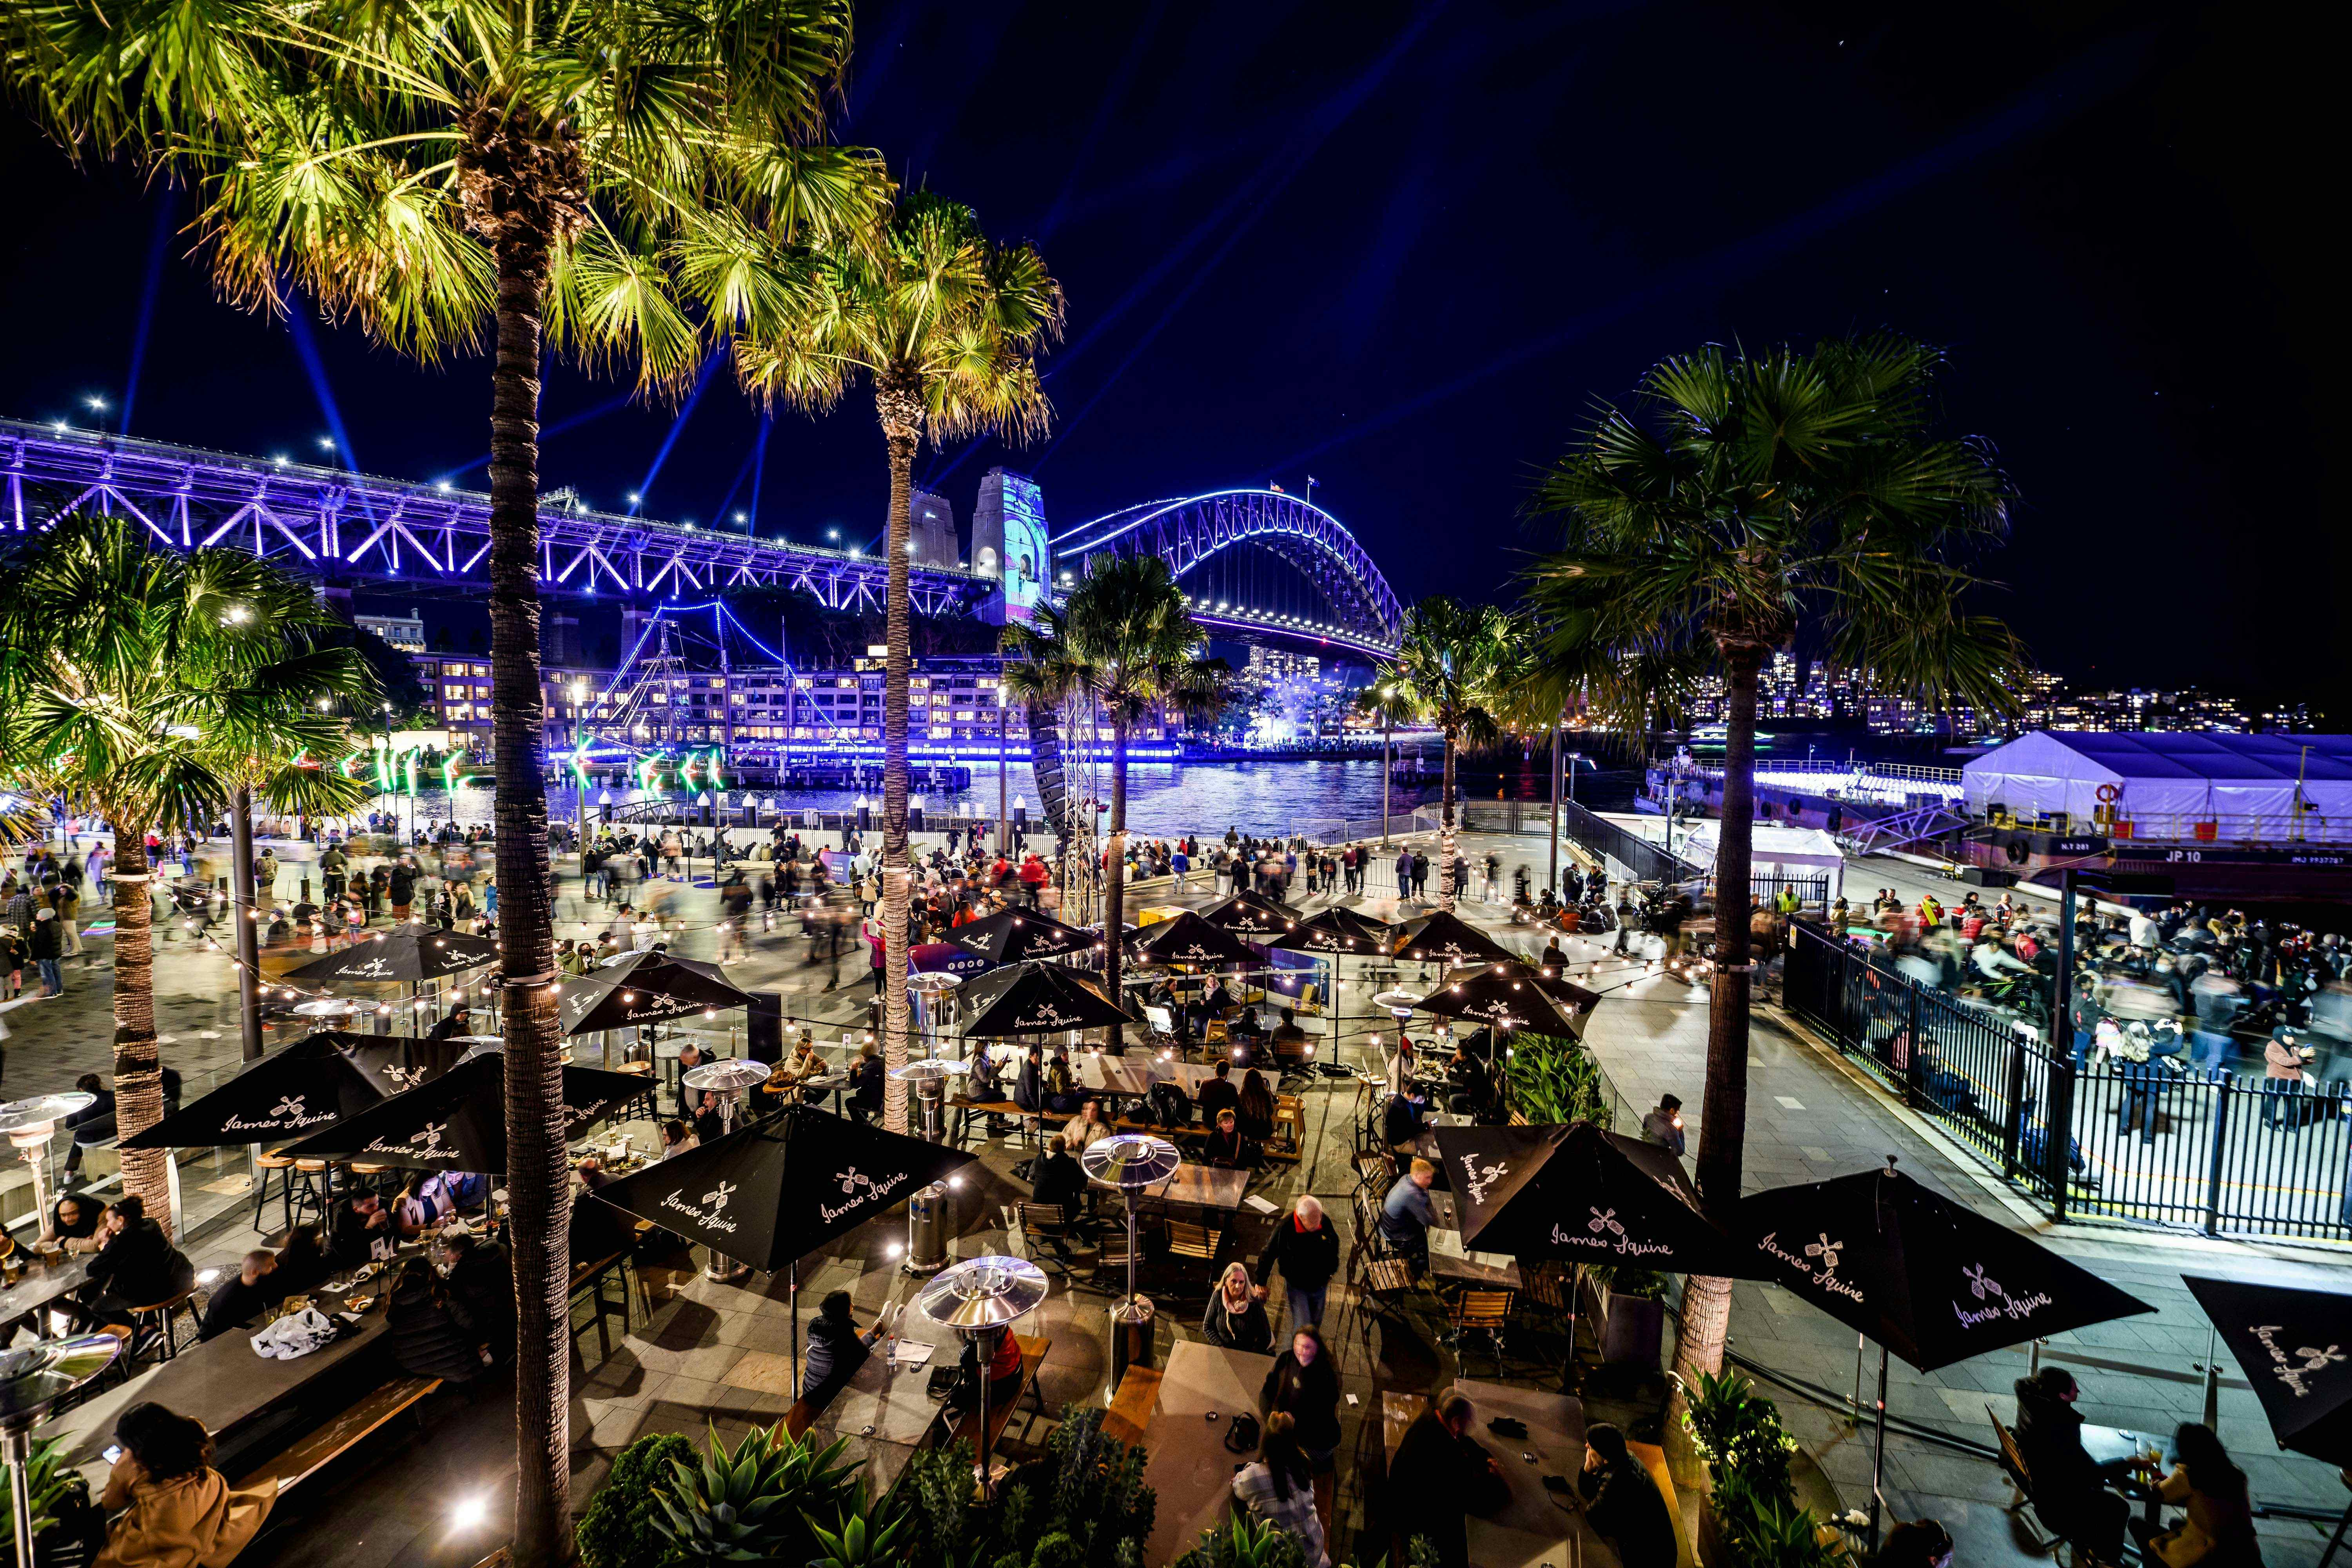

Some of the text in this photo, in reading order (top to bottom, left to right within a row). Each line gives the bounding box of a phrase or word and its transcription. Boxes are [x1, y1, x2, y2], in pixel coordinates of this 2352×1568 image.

[2166, 851, 2201, 862] JP 10
[1047, 942, 1069, 951] Squire
[1172, 951, 1196, 960] James
[1303, 942, 1355, 953] James Squire
[1428, 949, 1453, 957] James
[467, 953, 490, 963] Squire
[1271, 960, 1295, 969] VIDSYDNEY.COM
[335, 965, 394, 977] James Squire
[627, 1002, 703, 1020] James Squire
[1462, 1004, 1494, 1019] James
[1014, 1015, 1082, 1027] James Squire
[409, 1066, 426, 1085] Squire
[575, 1098, 608, 1120] Squire
[221, 1111, 336, 1132] James Squire
[363, 1136, 460, 1160] James Squire
[1460, 1153, 1479, 1180] James
[821, 1172, 907, 1223] James Squire
[661, 1189, 737, 1232] James Squire
[1552, 1223, 1673, 1256] James Squire
[1758, 1232, 1864, 1303] James Squire
[1953, 1290, 2052, 1329] James Squire
[2249, 1326, 2288, 1363] James
